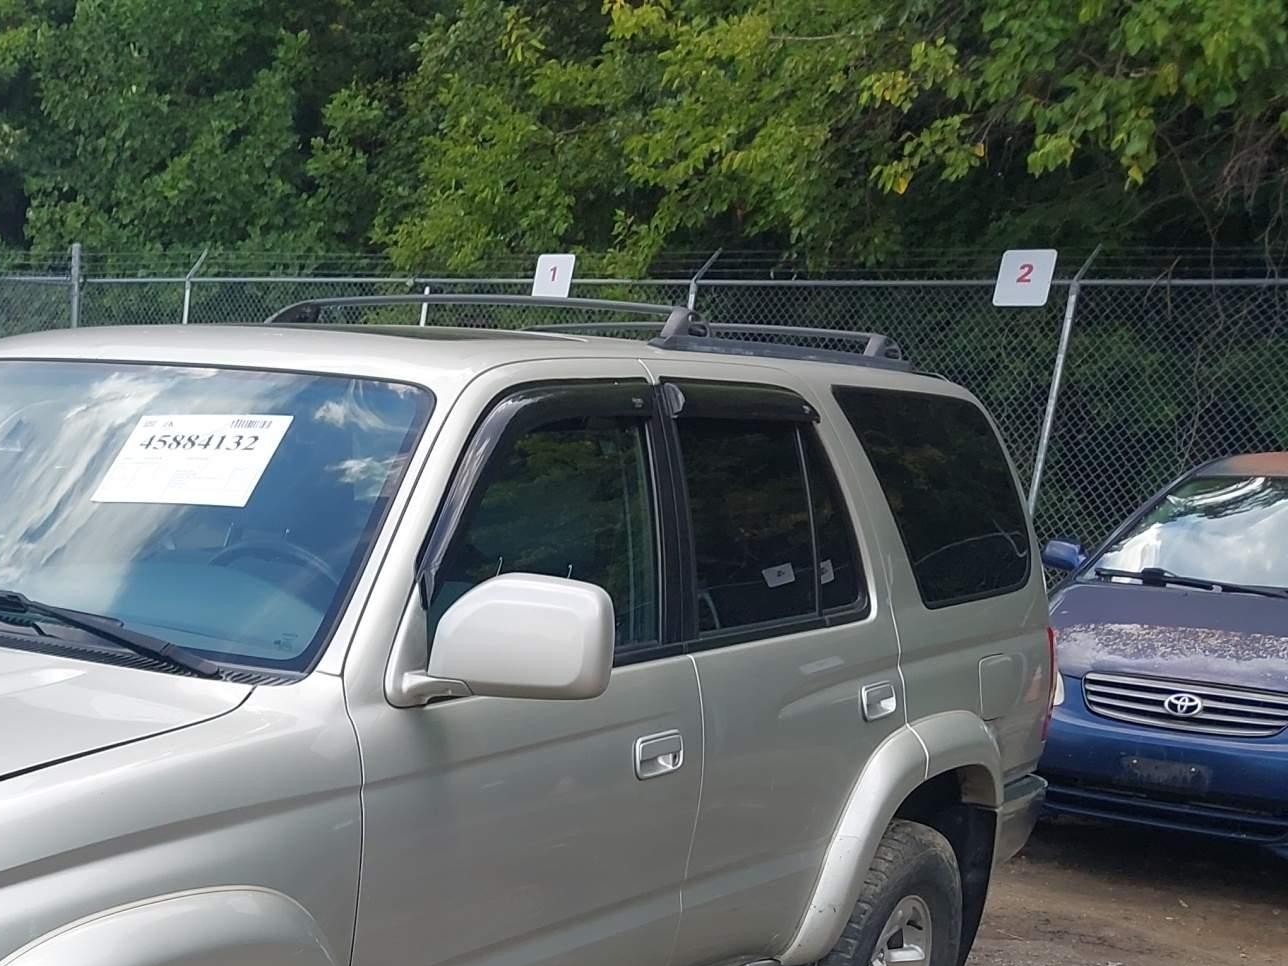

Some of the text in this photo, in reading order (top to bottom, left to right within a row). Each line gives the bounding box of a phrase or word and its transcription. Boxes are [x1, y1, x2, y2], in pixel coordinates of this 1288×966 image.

[550, 266, 558, 282] 1
[1016, 263, 1034, 283] 2
[140, 434, 260, 450] 45884132
